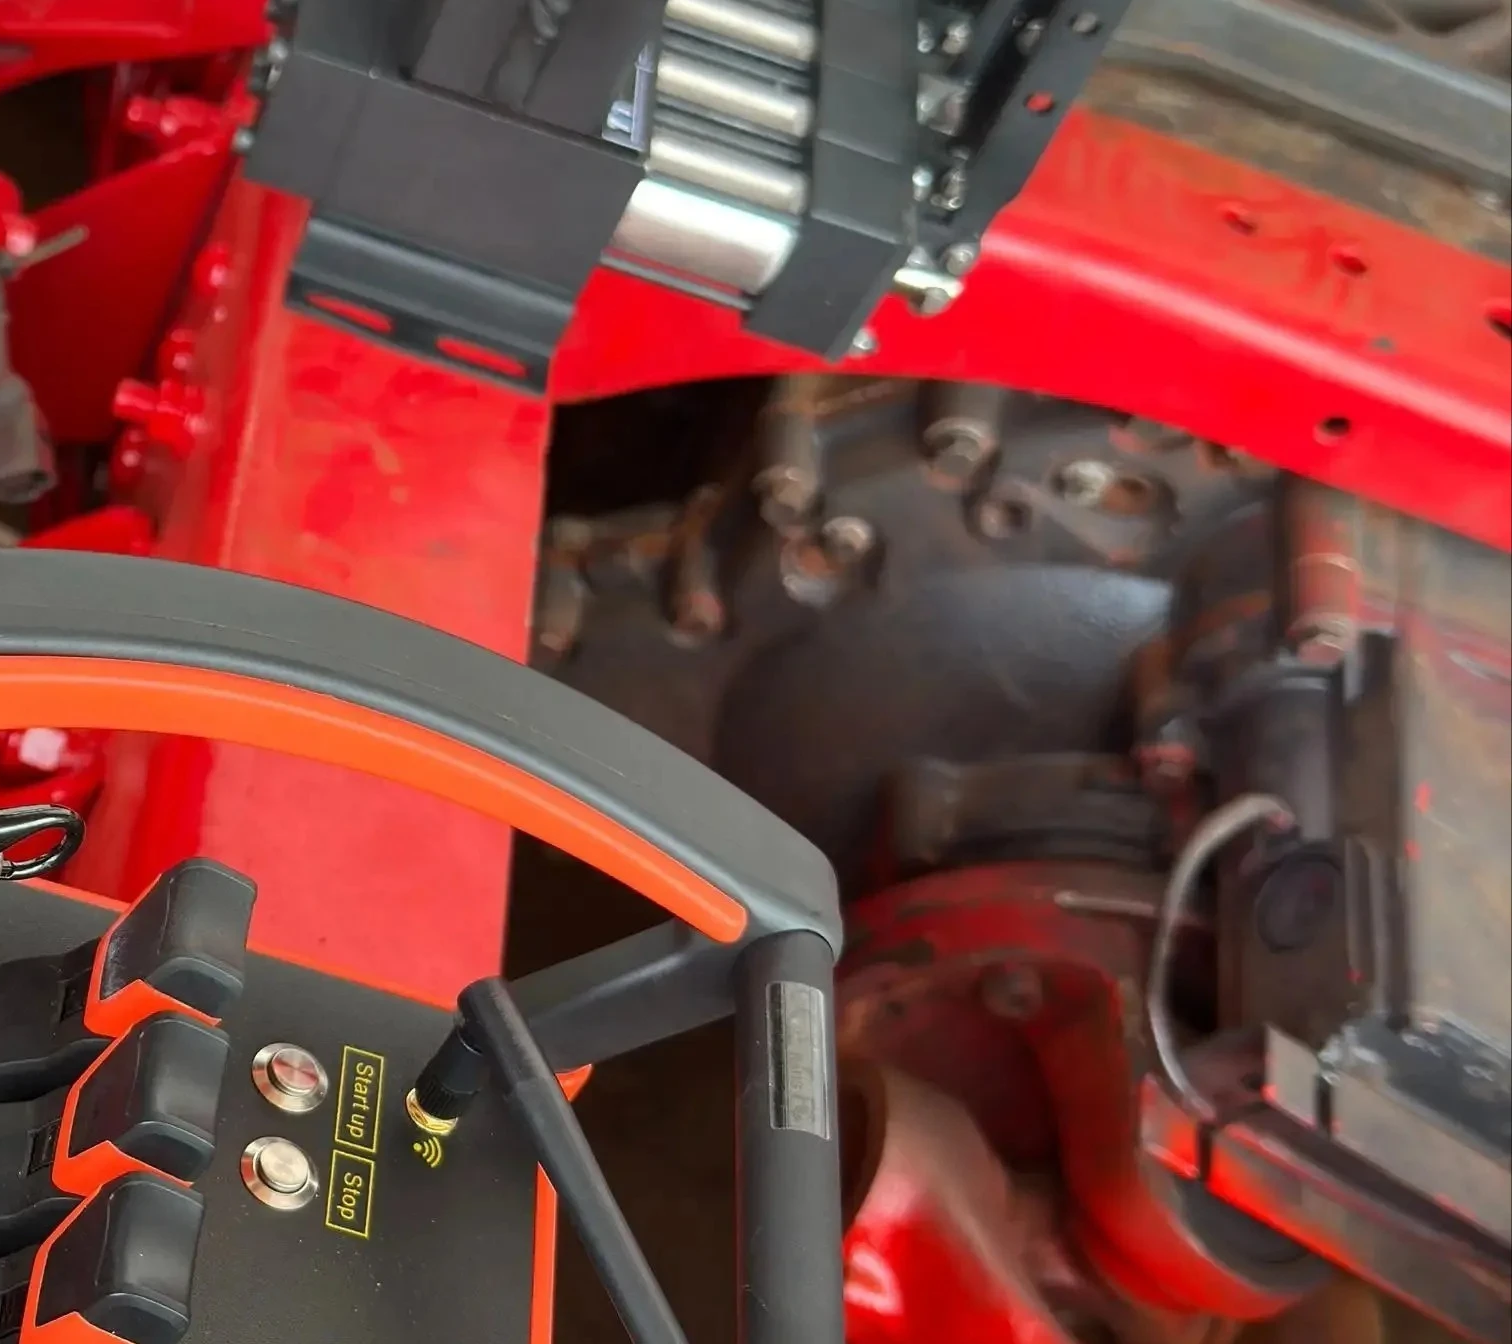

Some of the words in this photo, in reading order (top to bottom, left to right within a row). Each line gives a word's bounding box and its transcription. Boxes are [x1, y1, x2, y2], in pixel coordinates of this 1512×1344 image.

[351, 1062, 374, 1111] Start
[346, 1114, 366, 1138] up
[336, 1171, 363, 1220] Stop
